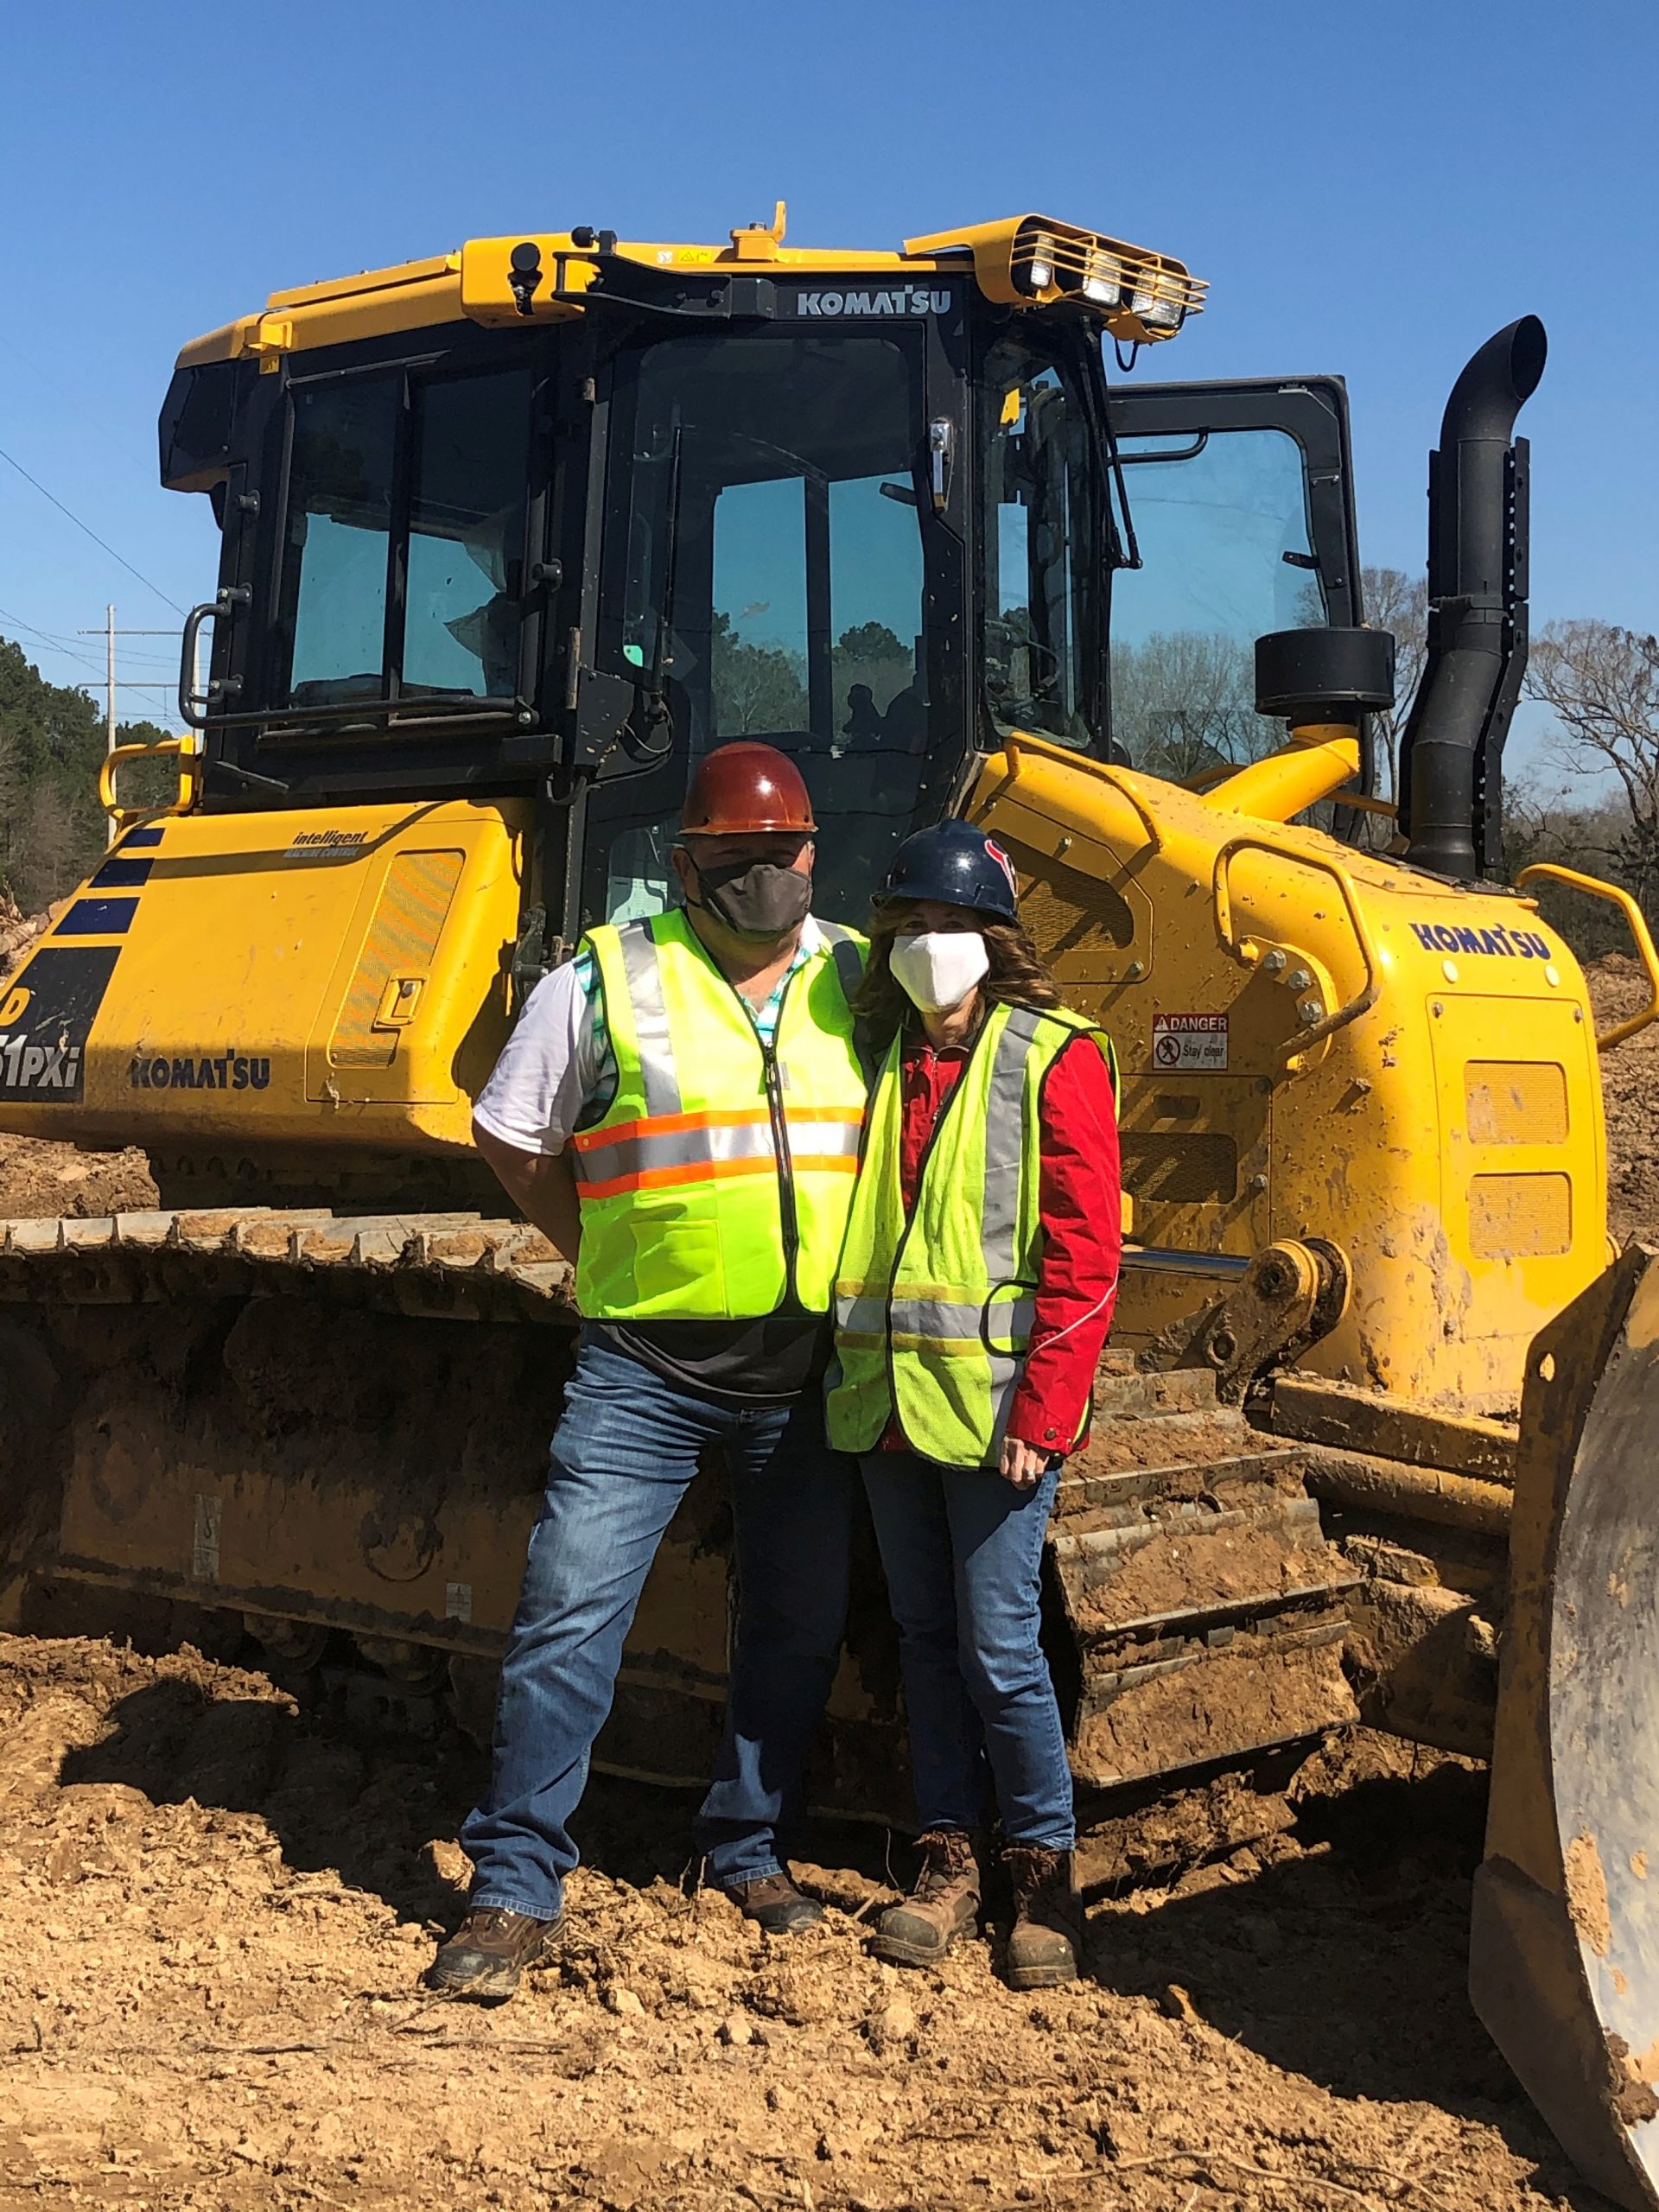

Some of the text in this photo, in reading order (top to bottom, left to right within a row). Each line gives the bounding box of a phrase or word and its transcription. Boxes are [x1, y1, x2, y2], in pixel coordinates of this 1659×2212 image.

[798, 284, 950, 315] KOMATSU
[292, 830, 369, 847] intelligent
[1408, 923, 1551, 960] KOMATSU
[1171, 1018, 1227, 1031] DANGER
[1183, 1044, 1224, 1058] Stay clear
[130, 1049, 270, 1090] KOMATSU
